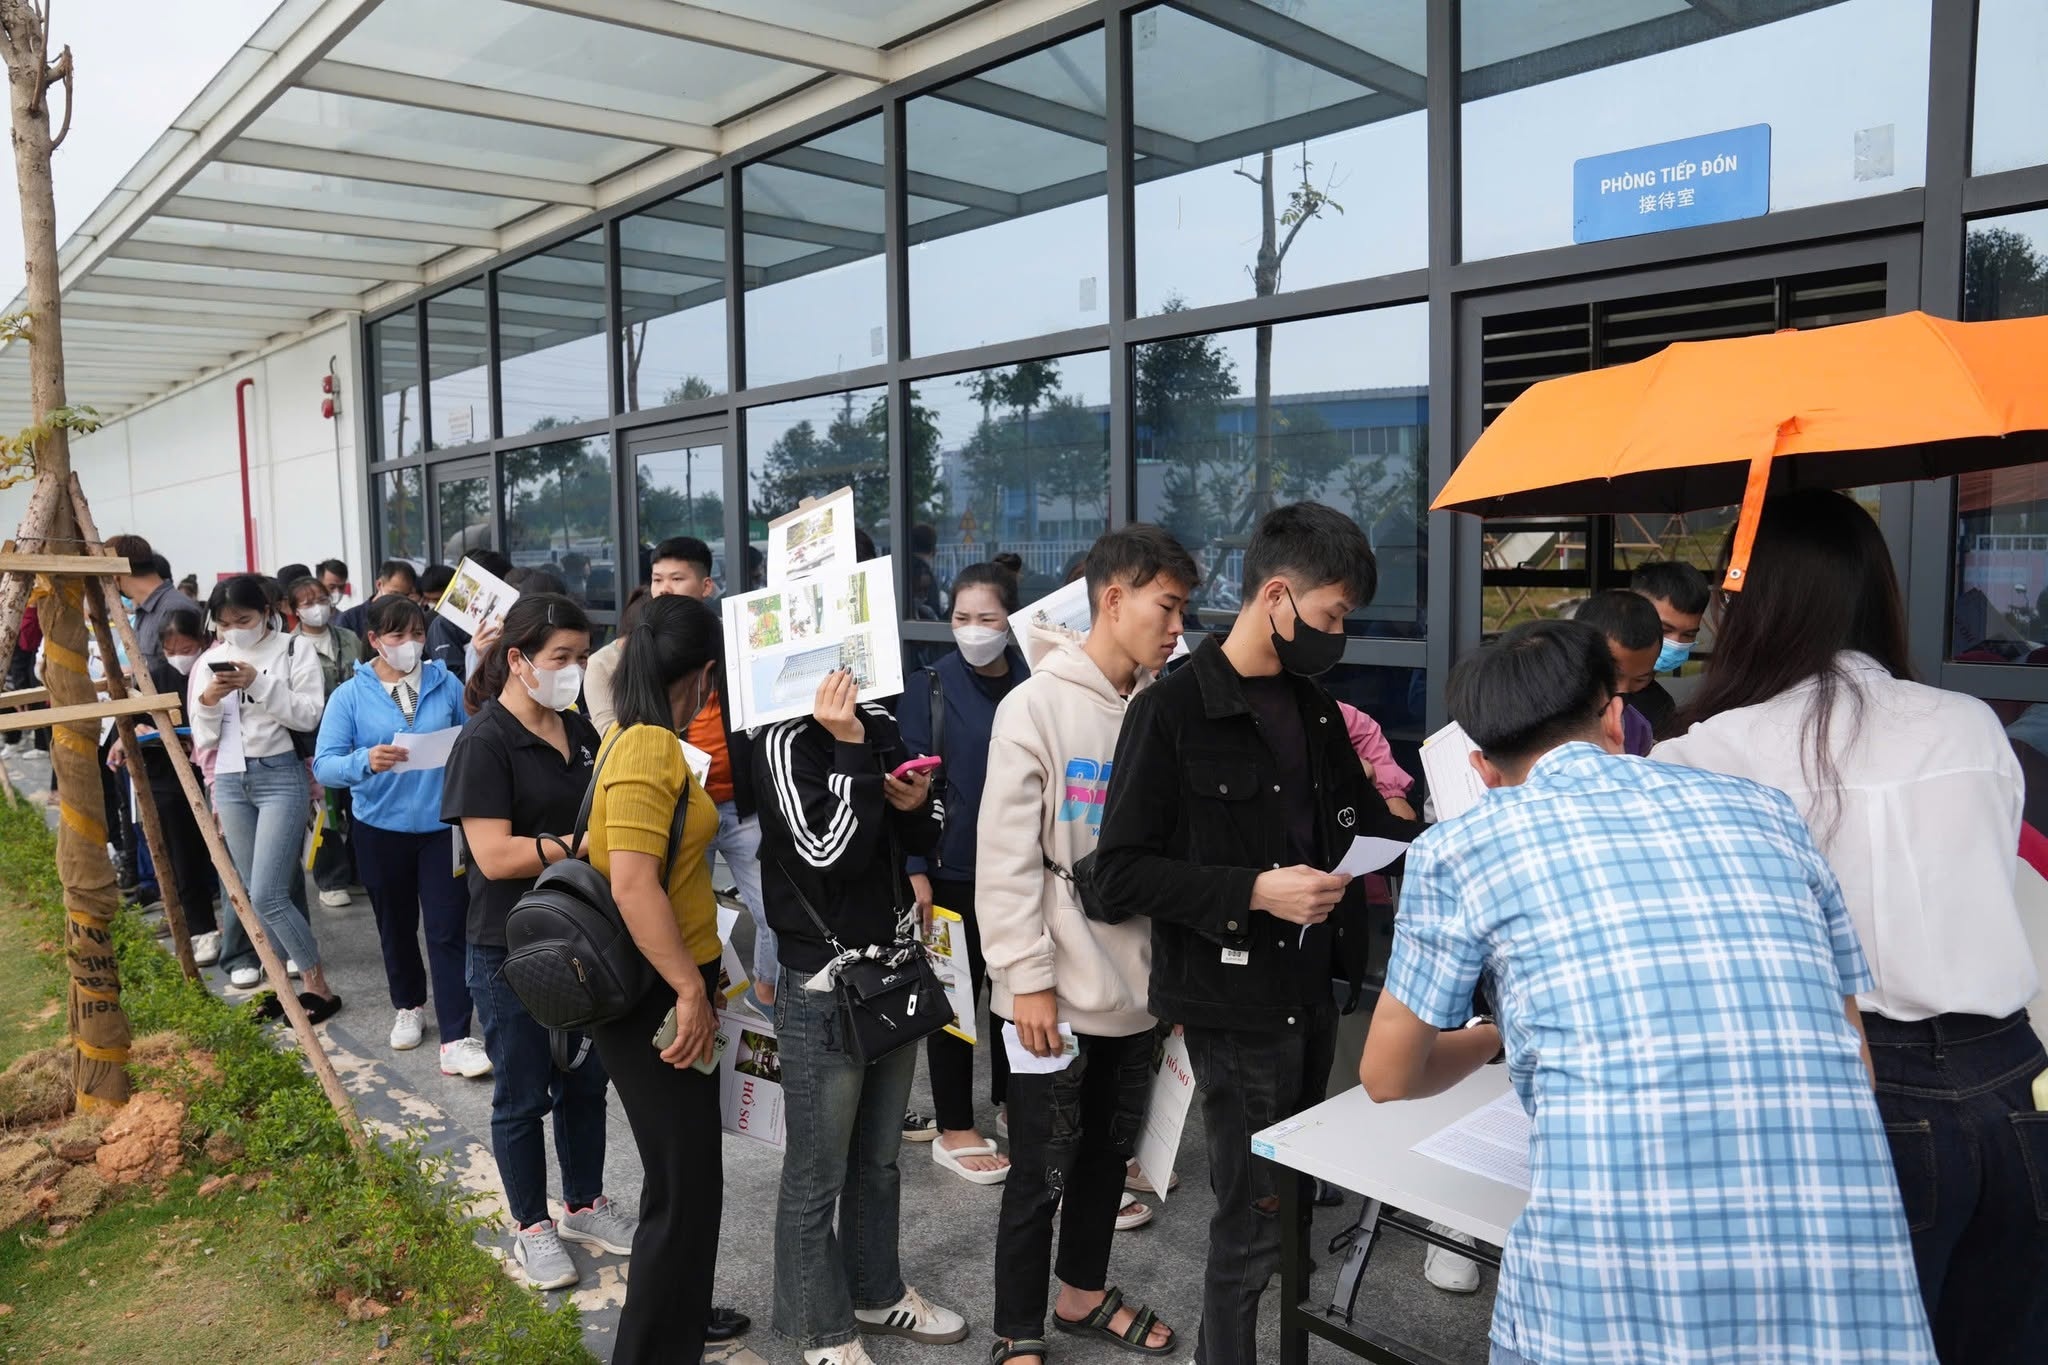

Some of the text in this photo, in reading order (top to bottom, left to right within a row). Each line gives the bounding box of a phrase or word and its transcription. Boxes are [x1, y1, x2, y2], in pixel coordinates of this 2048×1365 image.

[1600, 154, 1738, 195] PHÒNG TIẾP ĐÓN
[1638, 188, 1695, 214] 接待室
[741, 1080, 756, 1106] HỒ
